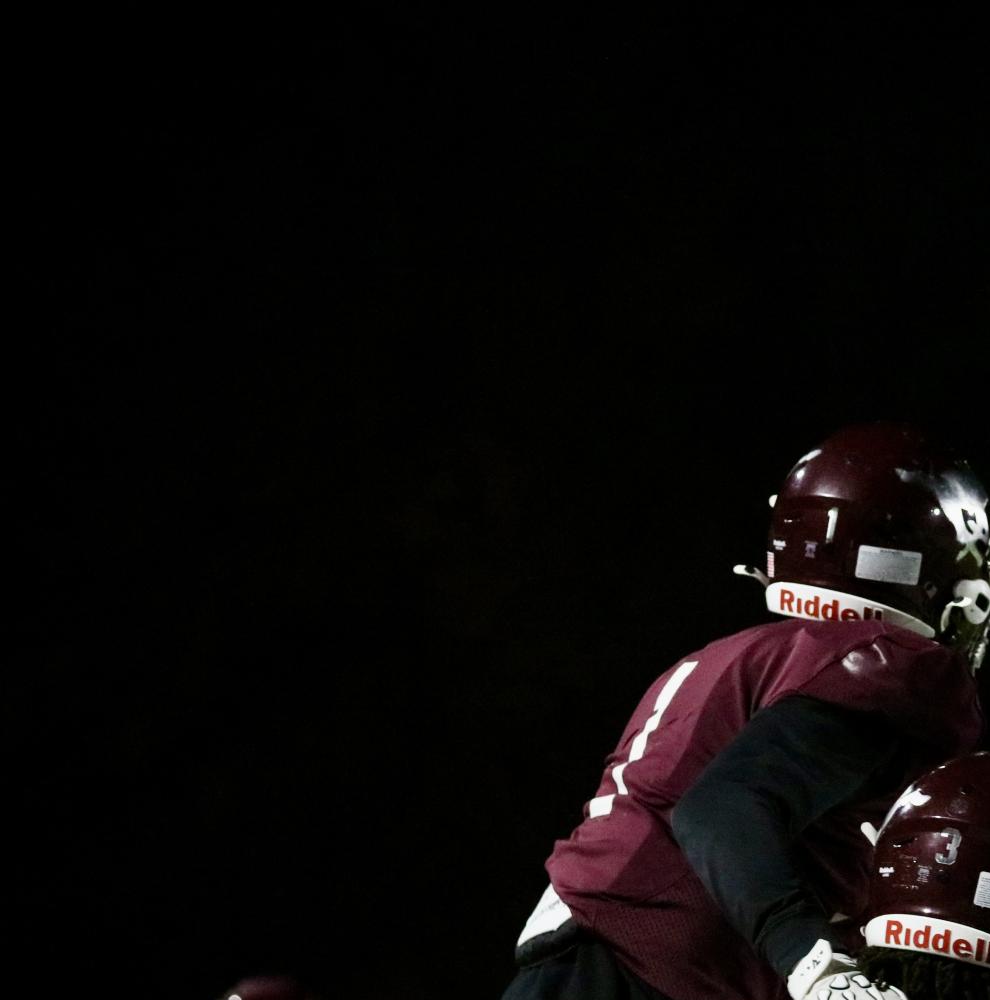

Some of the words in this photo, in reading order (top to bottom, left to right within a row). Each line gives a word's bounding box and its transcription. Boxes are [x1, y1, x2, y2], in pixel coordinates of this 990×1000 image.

[826, 507, 840, 545] 1
[590, 661, 699, 819] 1
[937, 827, 962, 865] 3
